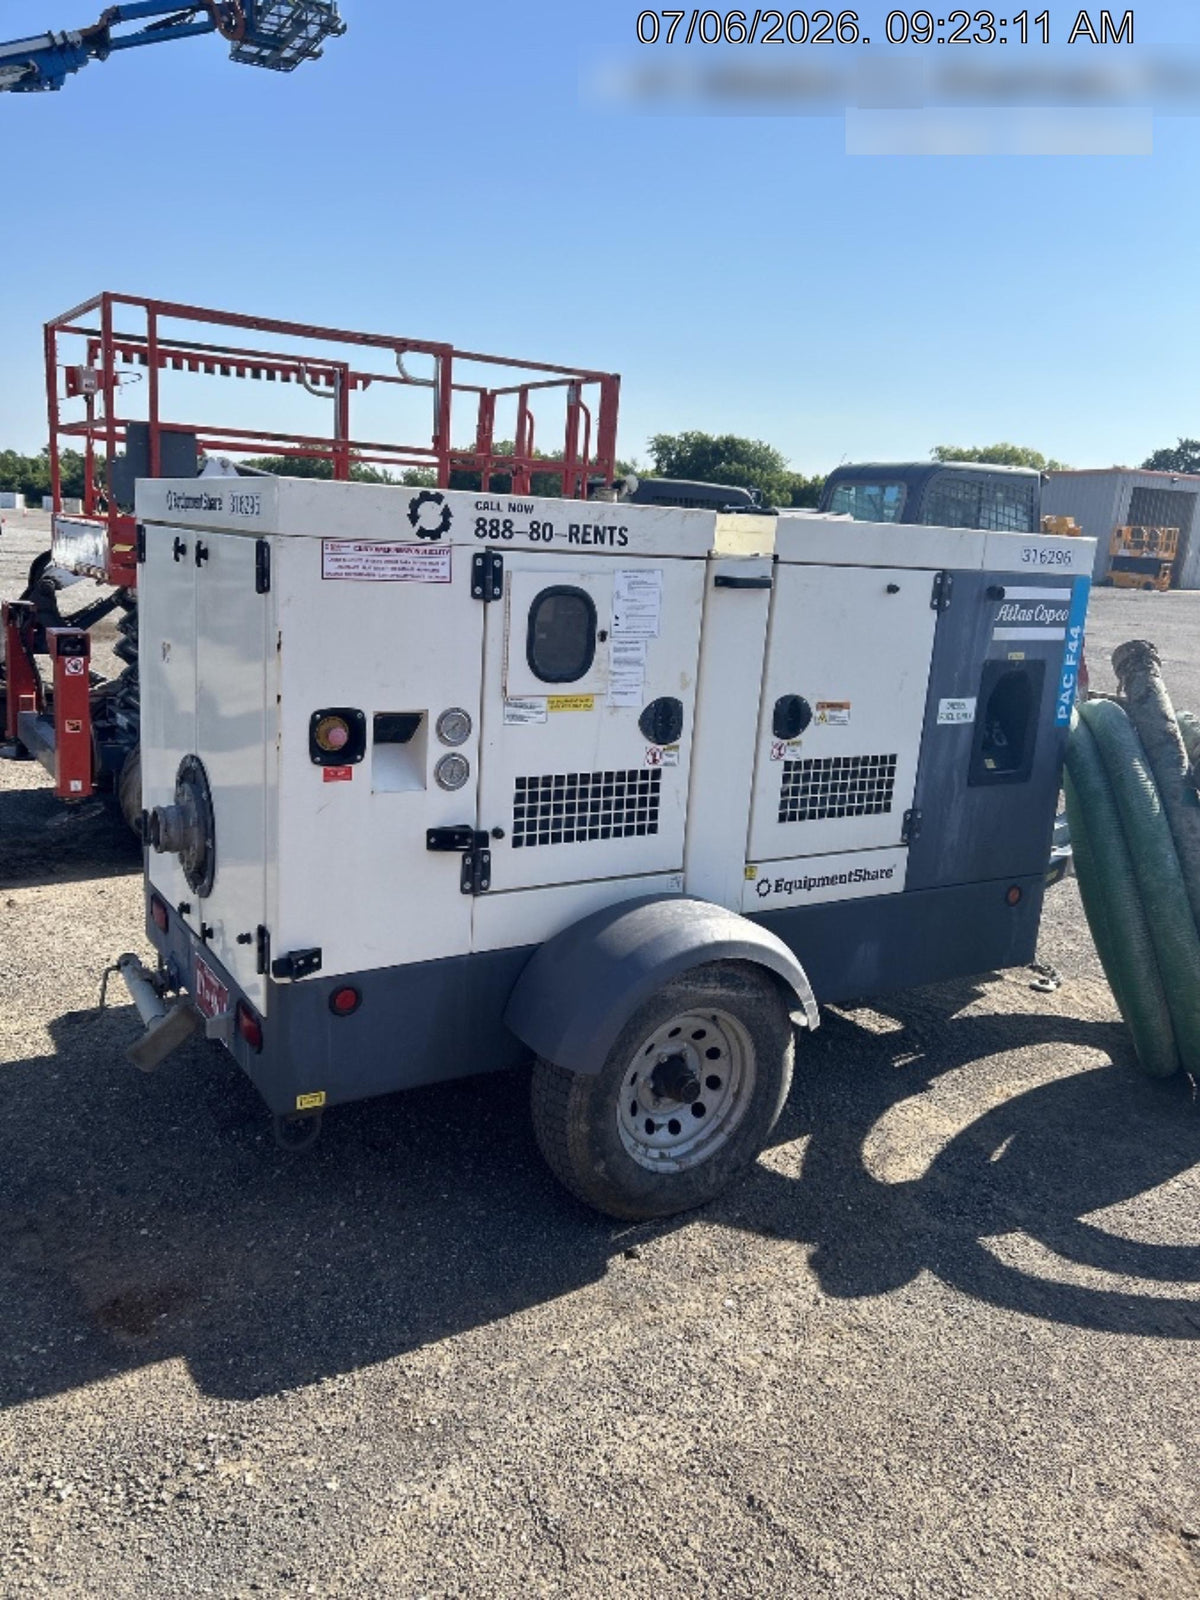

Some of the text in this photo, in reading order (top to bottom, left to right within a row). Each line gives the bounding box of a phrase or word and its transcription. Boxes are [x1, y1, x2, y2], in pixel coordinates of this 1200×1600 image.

[475, 501, 534, 514] CALL NOW
[474, 517, 628, 547] 888-80-RENTS
[1022, 548, 1072, 566] 316296
[995, 603, 1069, 625] Atlas Copco
[1058, 626, 1082, 719] PAC F44
[773, 866, 894, 894] EquipmentShare
